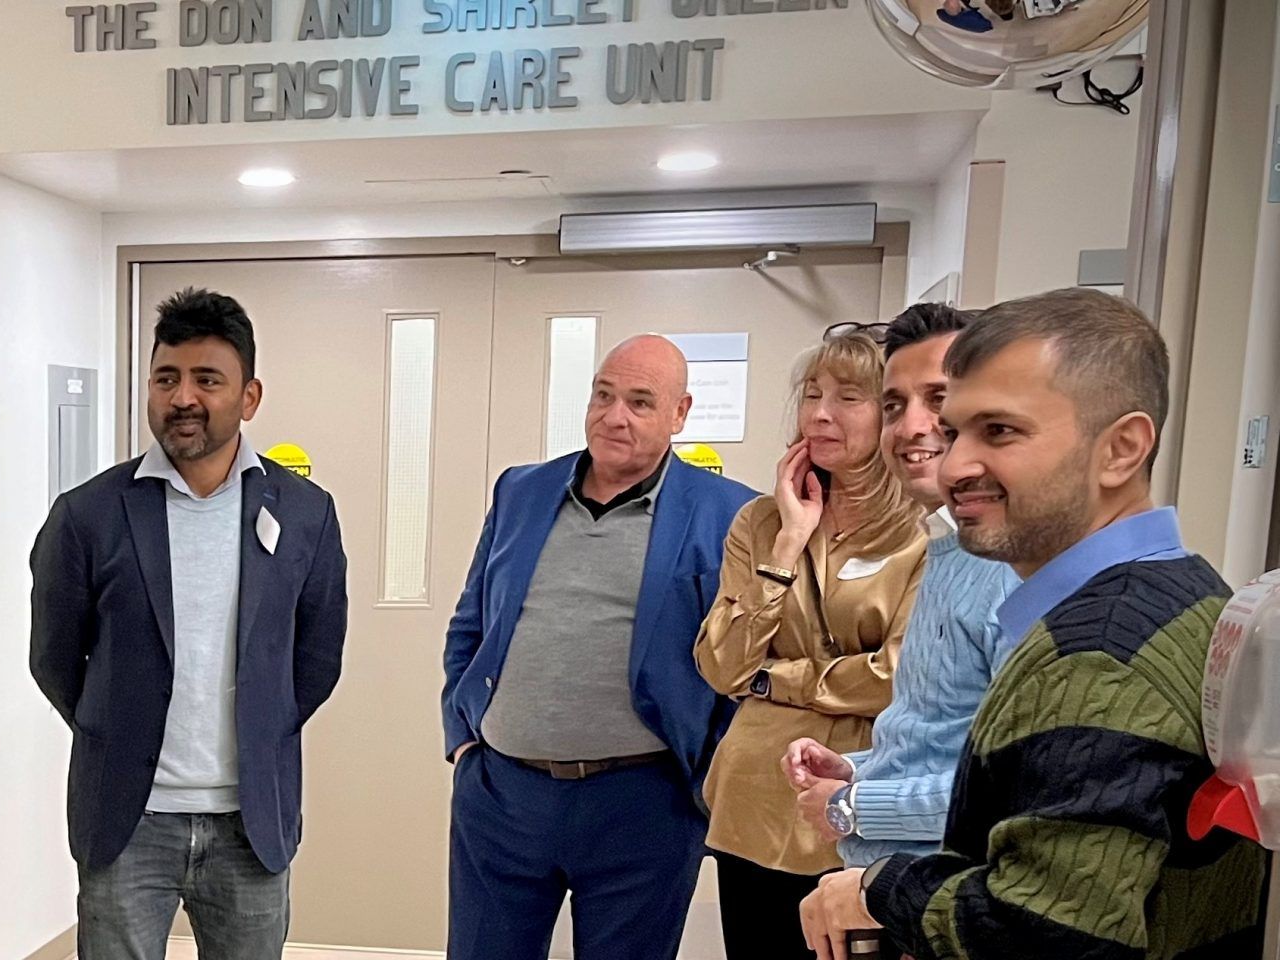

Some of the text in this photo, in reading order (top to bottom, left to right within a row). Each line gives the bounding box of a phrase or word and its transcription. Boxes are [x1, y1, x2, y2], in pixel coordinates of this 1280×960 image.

[66, 2, 157, 53] THE
[179, 0, 272, 48] DON
[298, 0, 391, 41] AND
[166, 38, 725, 126] INTENSIVE CARE UNIT
